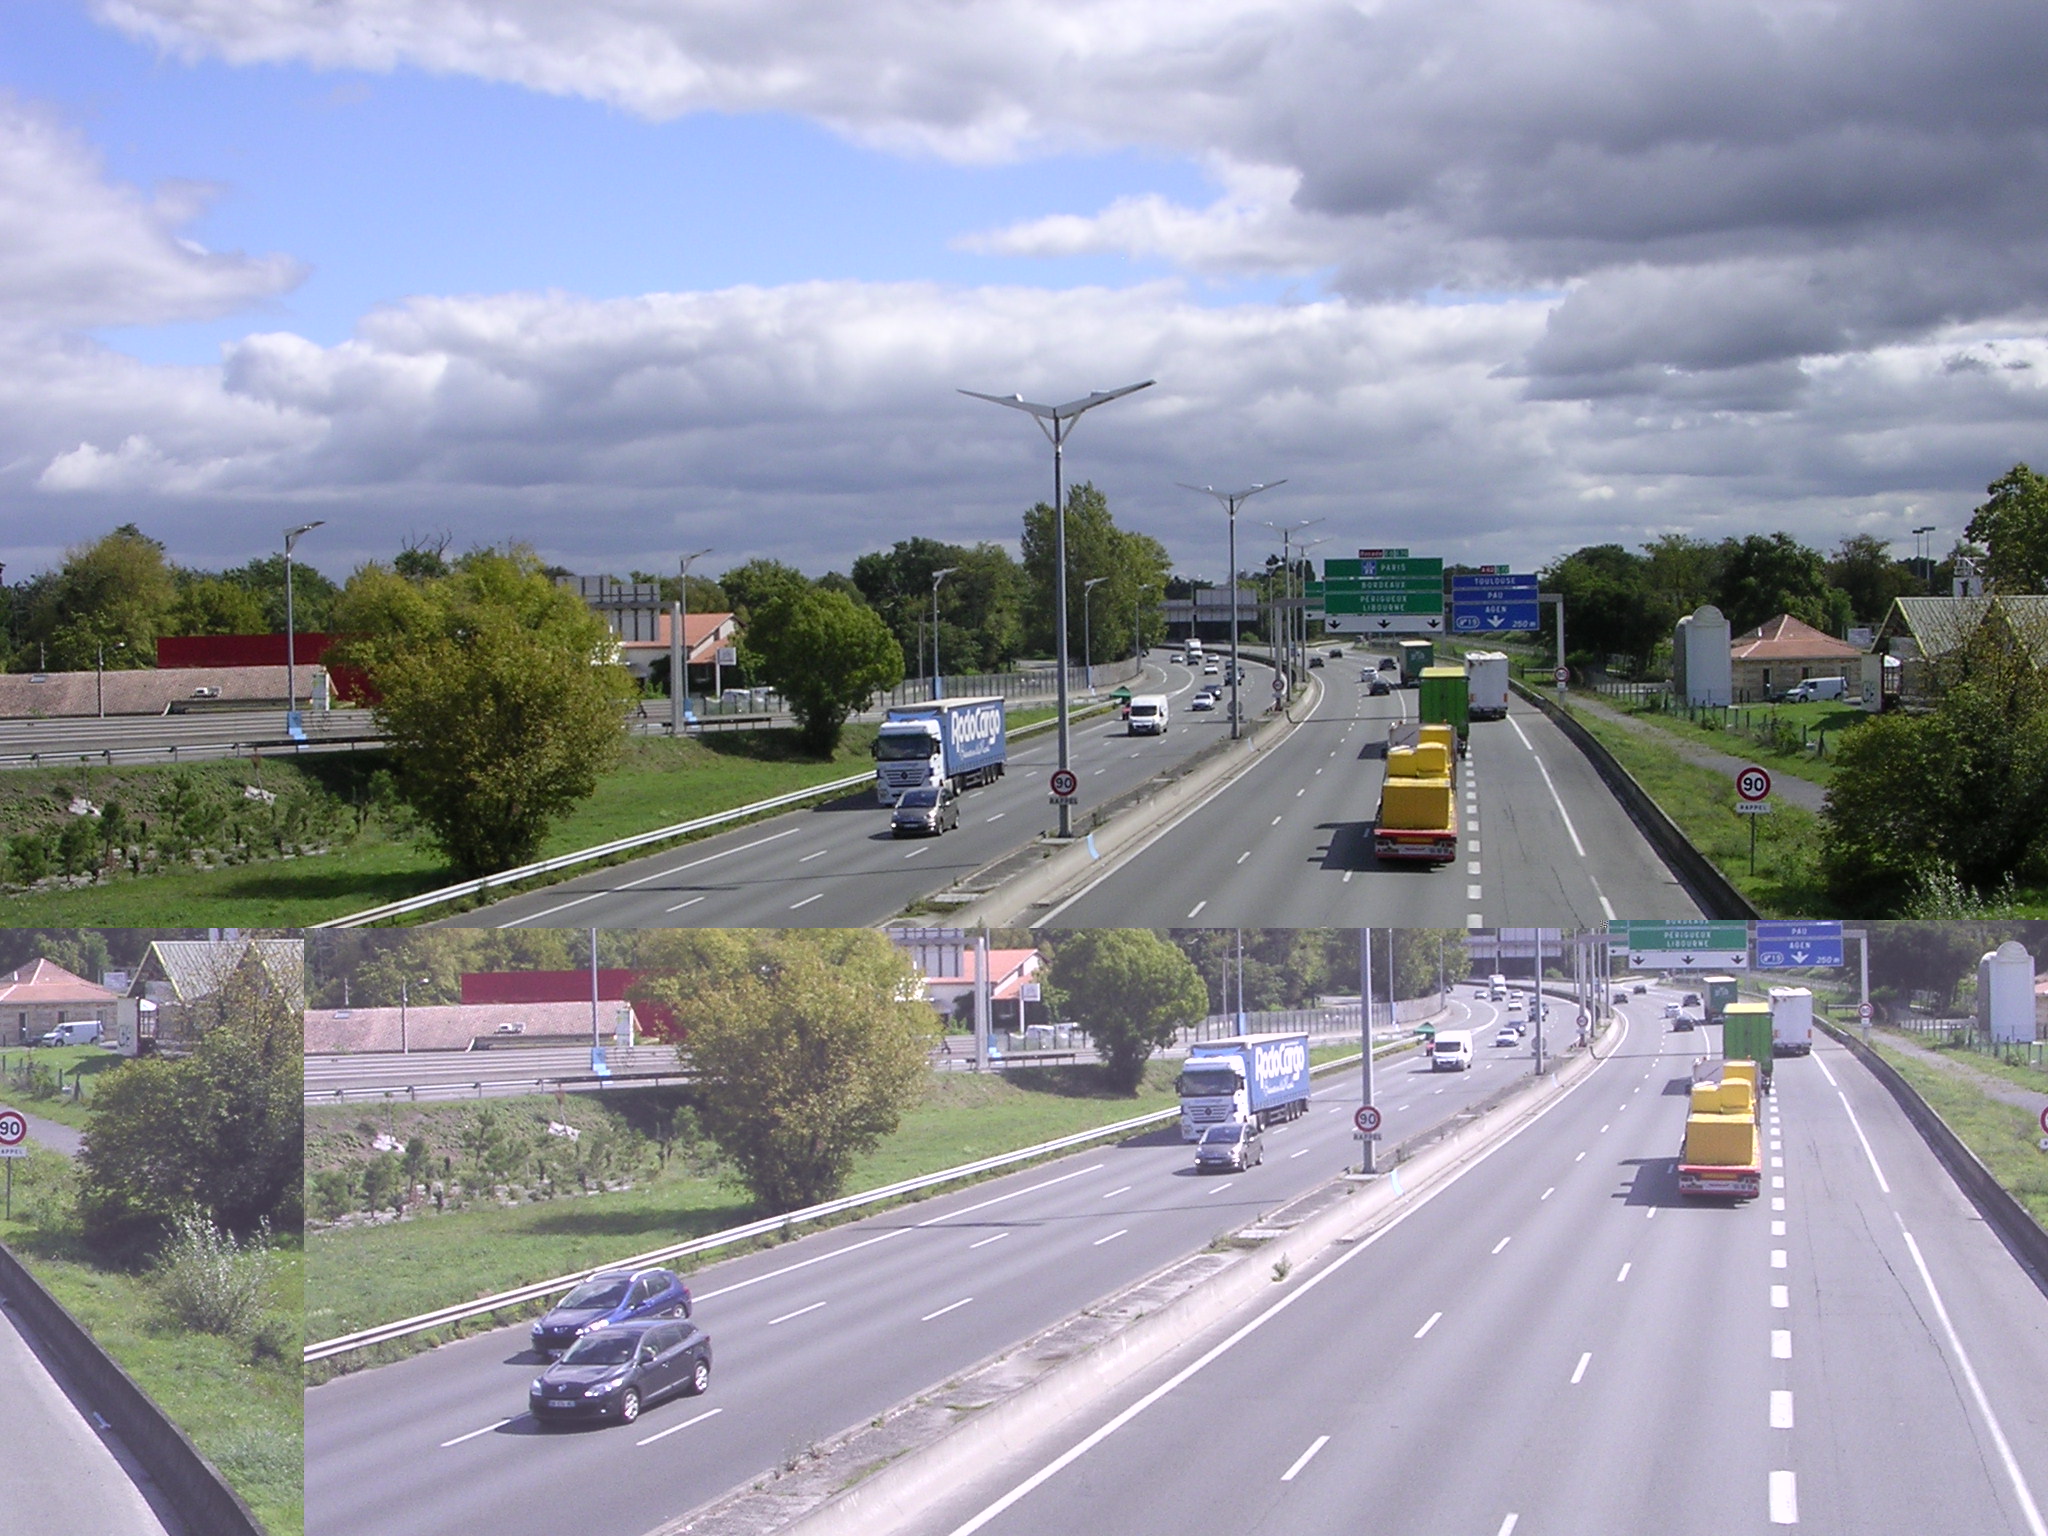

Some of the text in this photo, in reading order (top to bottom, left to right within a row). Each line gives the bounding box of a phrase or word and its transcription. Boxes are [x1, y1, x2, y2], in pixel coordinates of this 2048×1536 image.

[1512, 620, 1528, 628] 250
[951, 706, 1001, 753] RodoCargo
[1055, 777, 1072, 789] 90
[1743, 777, 1764, 791] 90
[1049, 797, 1078, 805] RAPPEL
[1816, 956, 1832, 964] 250
[1255, 1043, 1305, 1089] RodoCargo
[1360, 1113, 1376, 1125] 90
[0, 1121, 20, 1135] 90
[1353, 1133, 1382, 1141] RAPPEL
